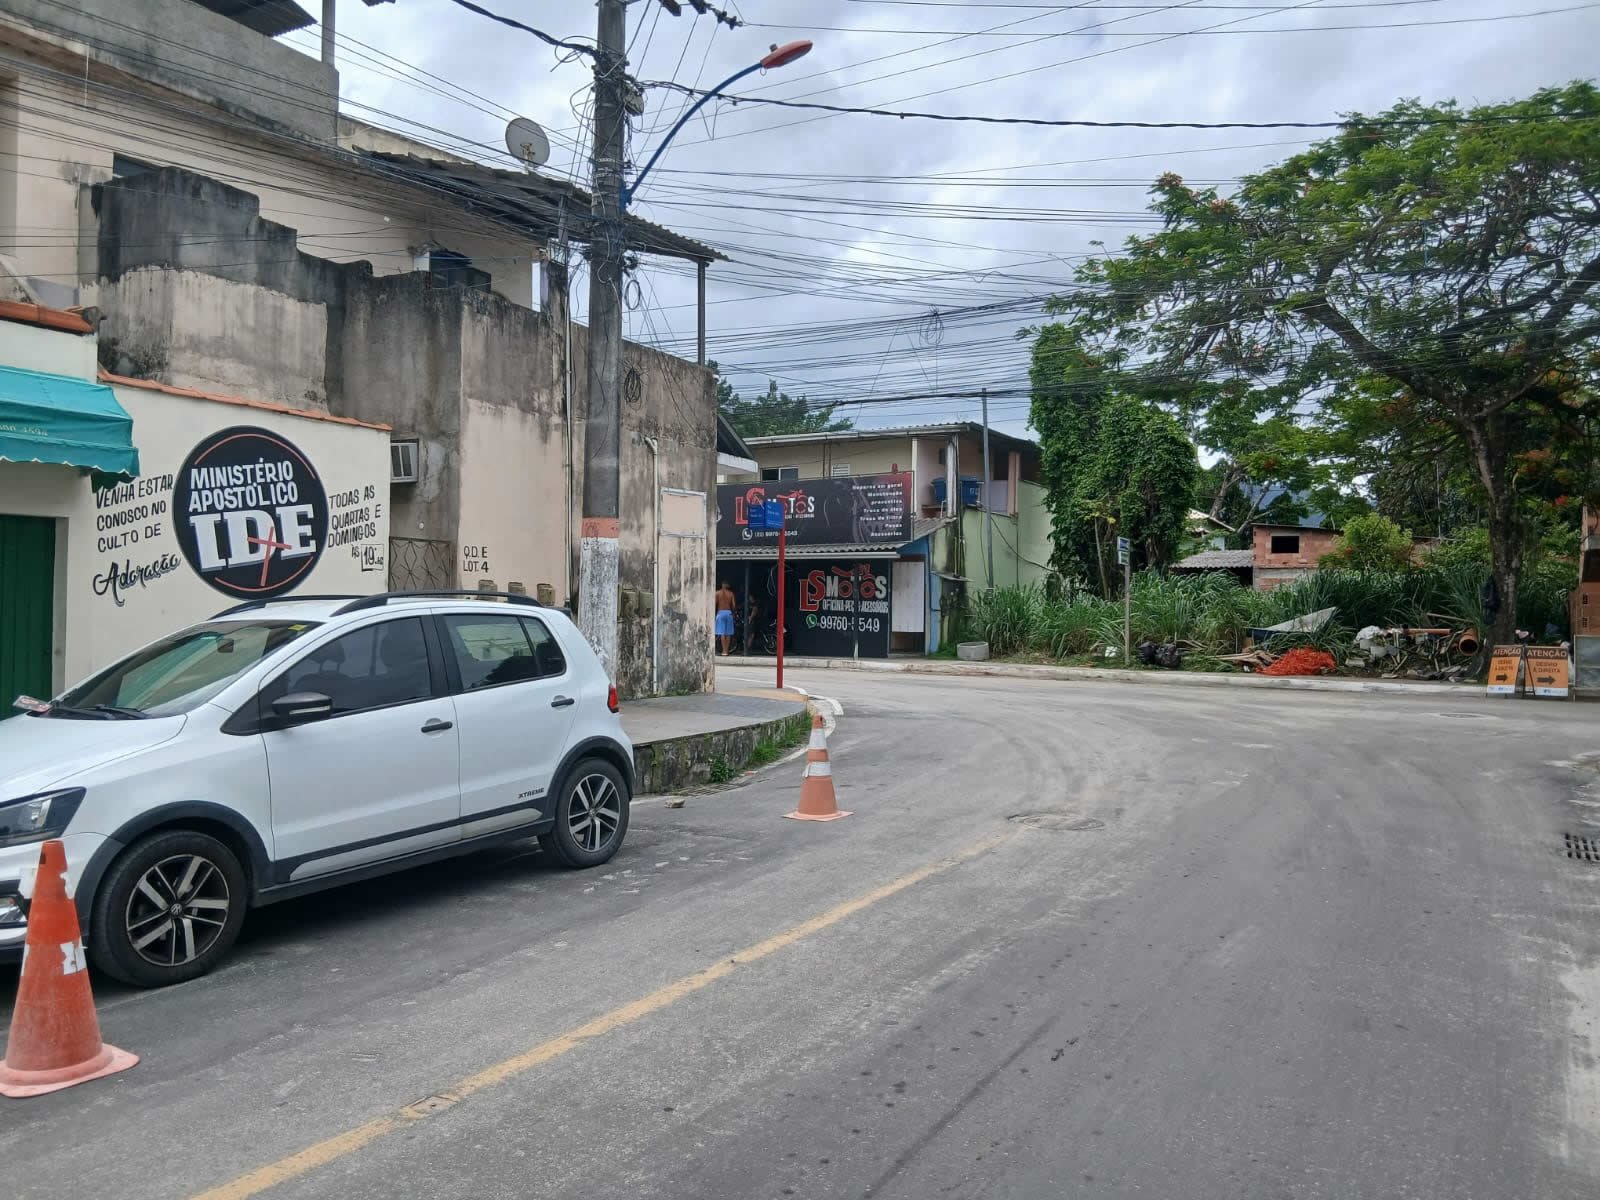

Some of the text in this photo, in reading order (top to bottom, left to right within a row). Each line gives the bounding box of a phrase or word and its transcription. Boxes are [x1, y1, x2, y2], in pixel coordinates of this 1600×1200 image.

[191, 457, 294, 489] MINISTÉRIO
[96, 474, 173, 509] VENHA ESTAR
[188, 481, 298, 512] APOSTÓLICO
[328, 484, 375, 509] TODAS AS
[97, 500, 167, 531] CONOSCO NO
[332, 504, 381, 530] QUARTAS E
[98, 523, 161, 552] CULTO DE
[189, 503, 317, 571] IDE
[328, 522, 376, 548] DOMINGOS
[481, 546, 489, 559] E
[93, 553, 181, 607] Adoração
[480, 561, 490, 574] 4
[1493, 647, 1521, 656] ATENÇÃO
[1526, 648, 1567, 658] ATENÇÃO
[518, 787, 545, 799] XTREME
